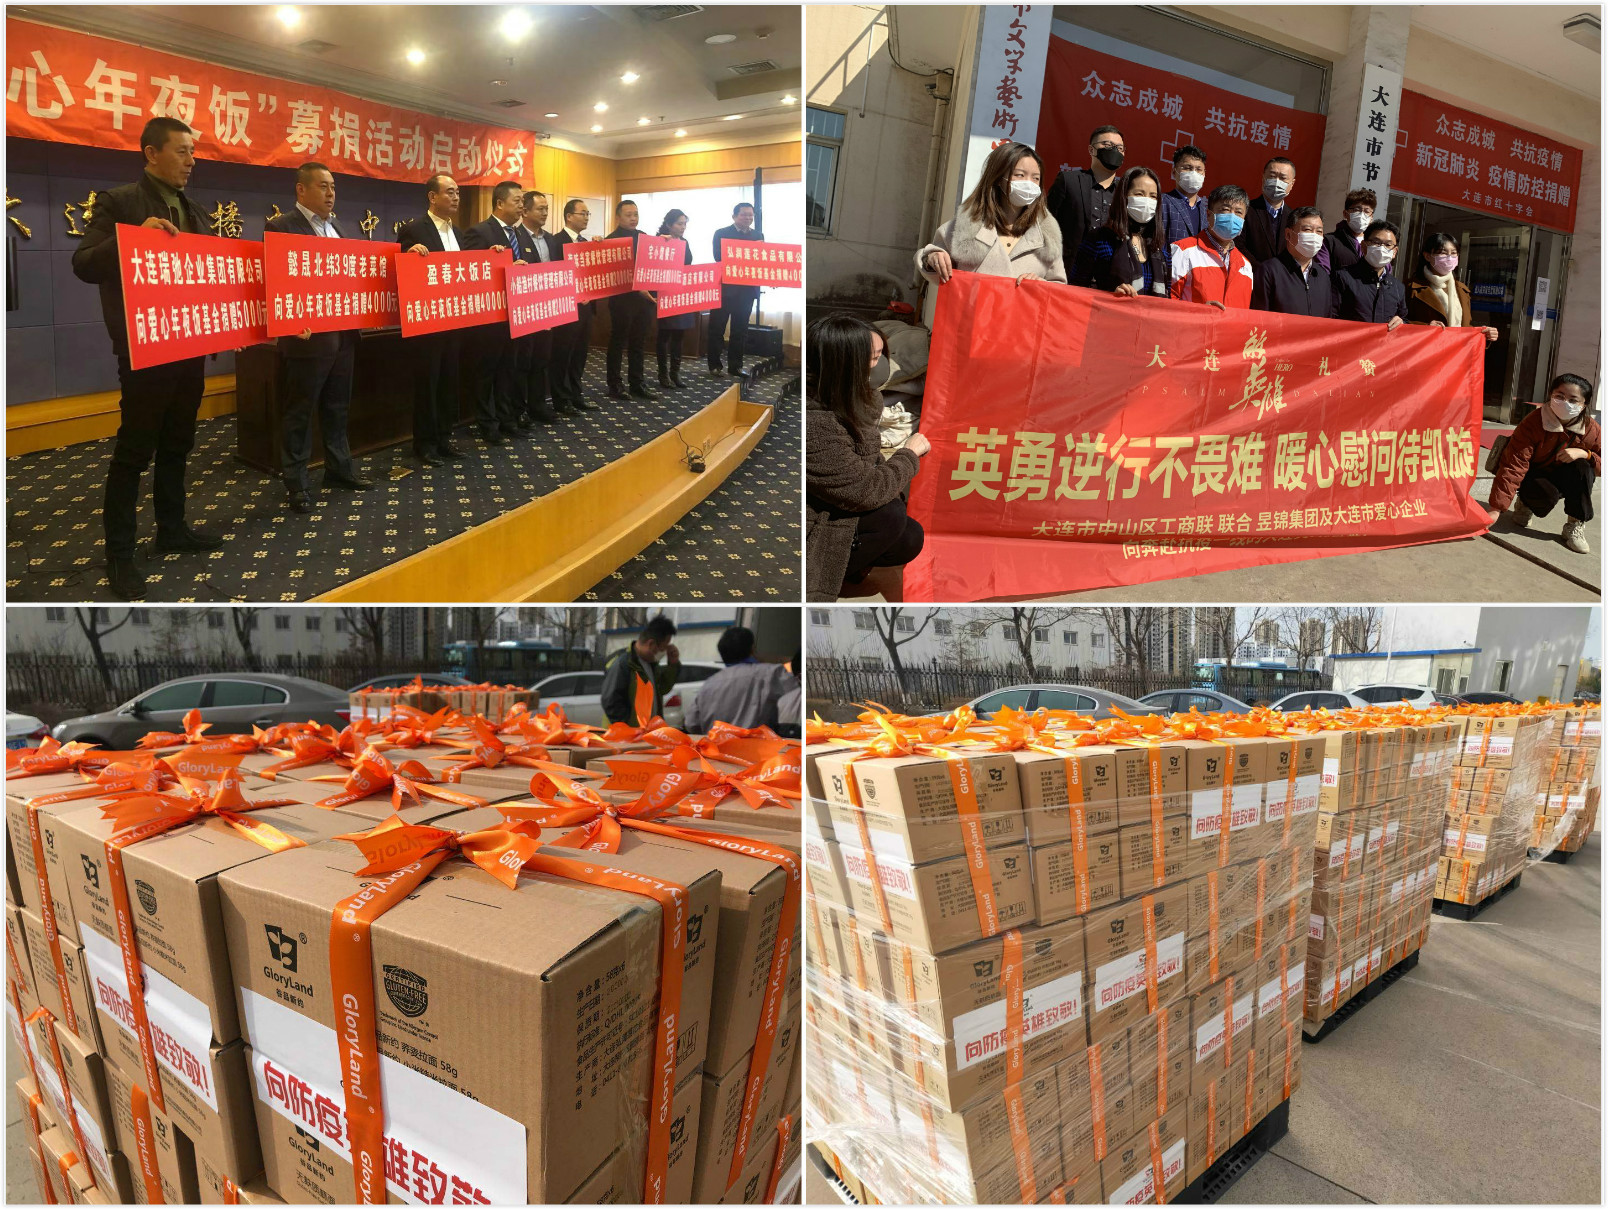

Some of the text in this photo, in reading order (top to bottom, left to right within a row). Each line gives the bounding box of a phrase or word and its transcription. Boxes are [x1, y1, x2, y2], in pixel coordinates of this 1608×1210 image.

[1081, 70, 1292, 151] 众志成城 共抗疫情
[1362, 86, 1390, 194] 大连市节
[1436, 114, 1563, 172] 众志成城 共抗疫情
[1416, 142, 1571, 208] 新冠肺炎 疫情防控捐赠
[1462, 189, 1534, 217] 大连市红十字会
[427, 261, 492, 286] 盈春大饭店
[949, 427, 1475, 502] 英勇逆行不畏难 暖心慰问待凯旋
[1031, 499, 1428, 538] 大连市中山区工商联 联合 昱锦集团及大连市爱心企业
[968, 821, 984, 869] GloryLand
[1196, 807, 1259, 834] 向防疫雄致敬!
[707, 838, 800, 881] GloryLand
[118, 909, 137, 986] GloryLand
[263, 966, 314, 998] GloryLand
[765, 937, 790, 1030] GloryLand
[139, 1025, 157, 1092] GloryLand
[342, 993, 368, 1099] GloryLand
[440, 1060, 458, 1079] 58g
[659, 1013, 676, 1124] GloryLand
[137, 1118, 153, 1176] GloryLand
[288, 1136, 335, 1177] GloryLand
